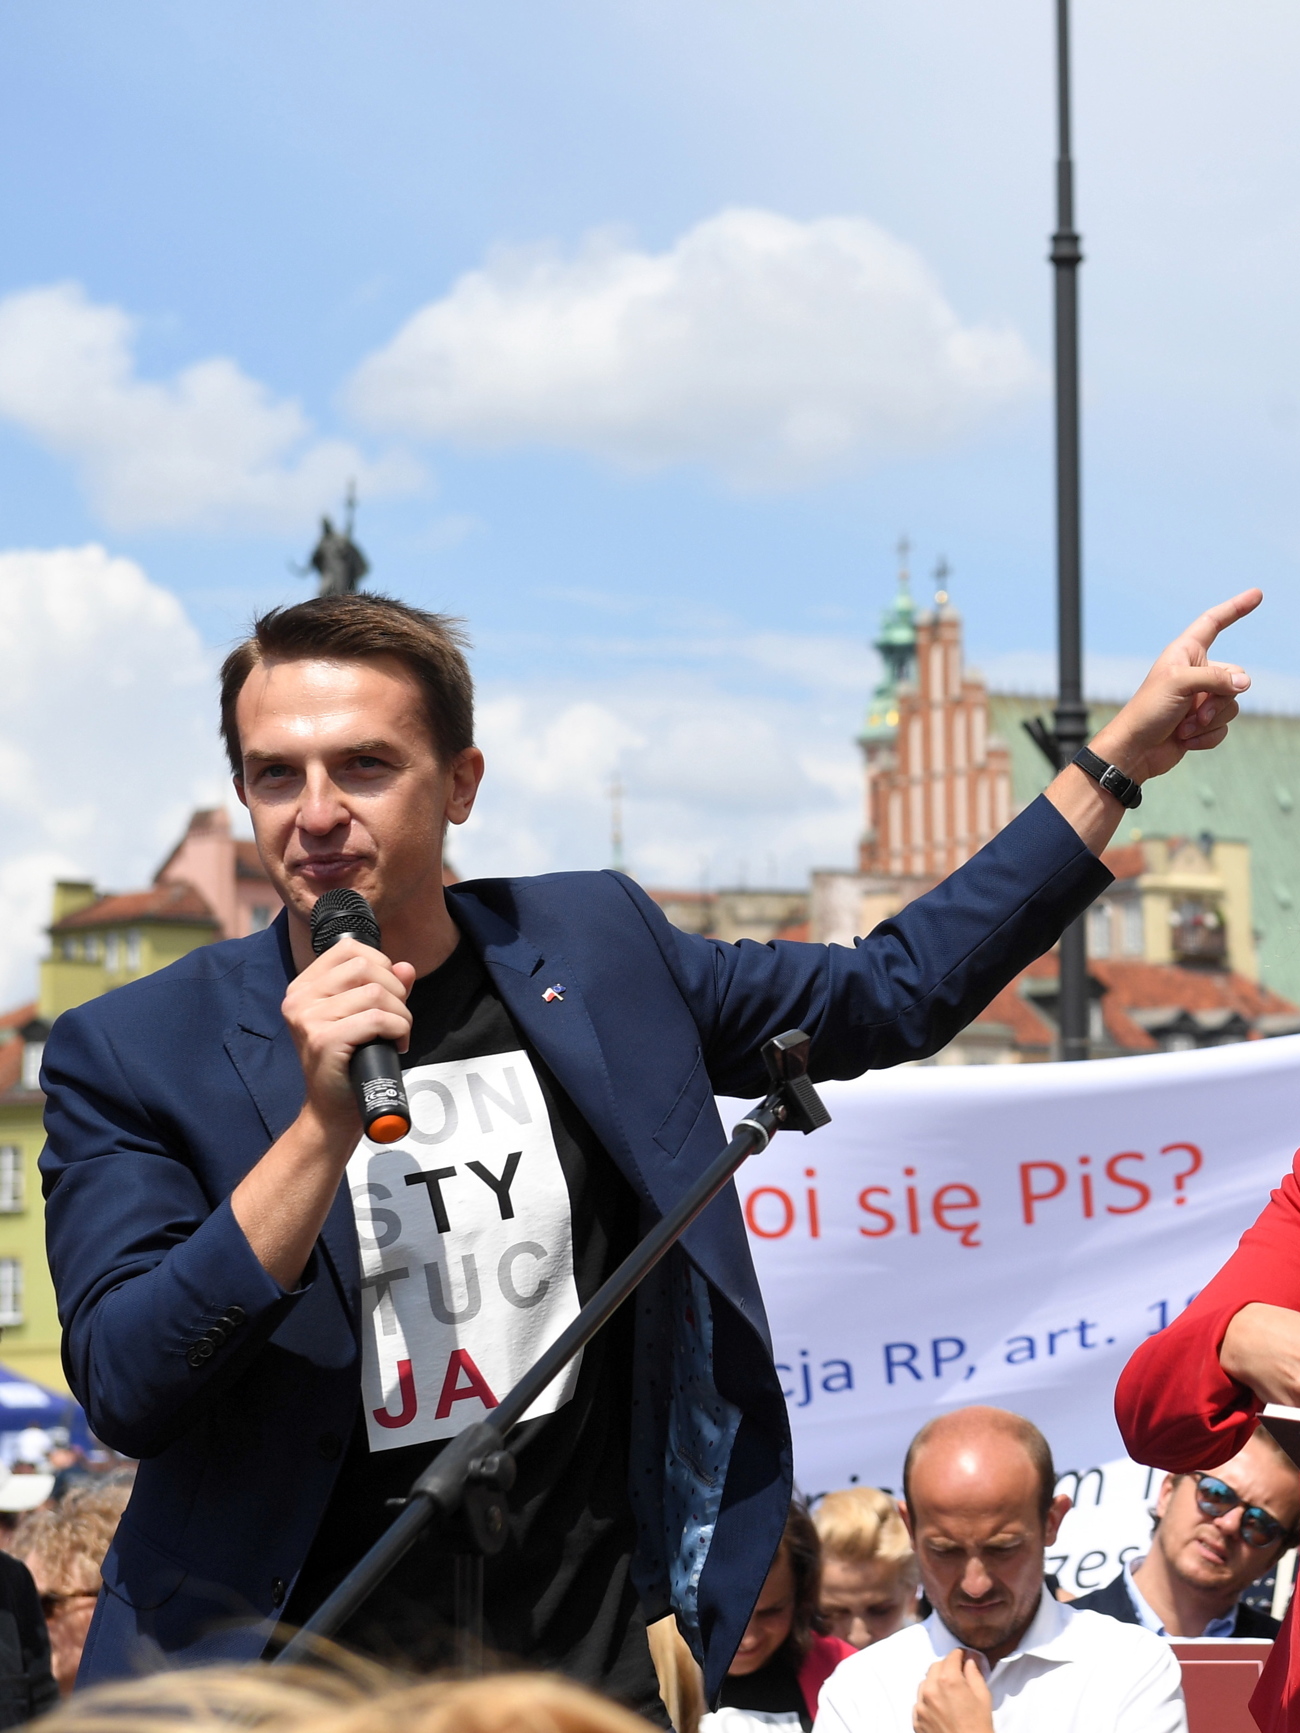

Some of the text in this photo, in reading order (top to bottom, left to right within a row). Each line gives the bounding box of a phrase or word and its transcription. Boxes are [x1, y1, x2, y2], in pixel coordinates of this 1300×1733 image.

[362, 1066, 533, 1155] ON
[350, 1151, 523, 1250] STY
[858, 1166, 982, 1248] się
[1019, 1142, 1203, 1226] PiS?
[361, 1241, 550, 1336] TUC
[883, 1336, 977, 1386] RP,
[1004, 1318, 1116, 1366] art.
[1147, 1293, 1199, 1335] 1
[372, 1348, 500, 1429] JA
